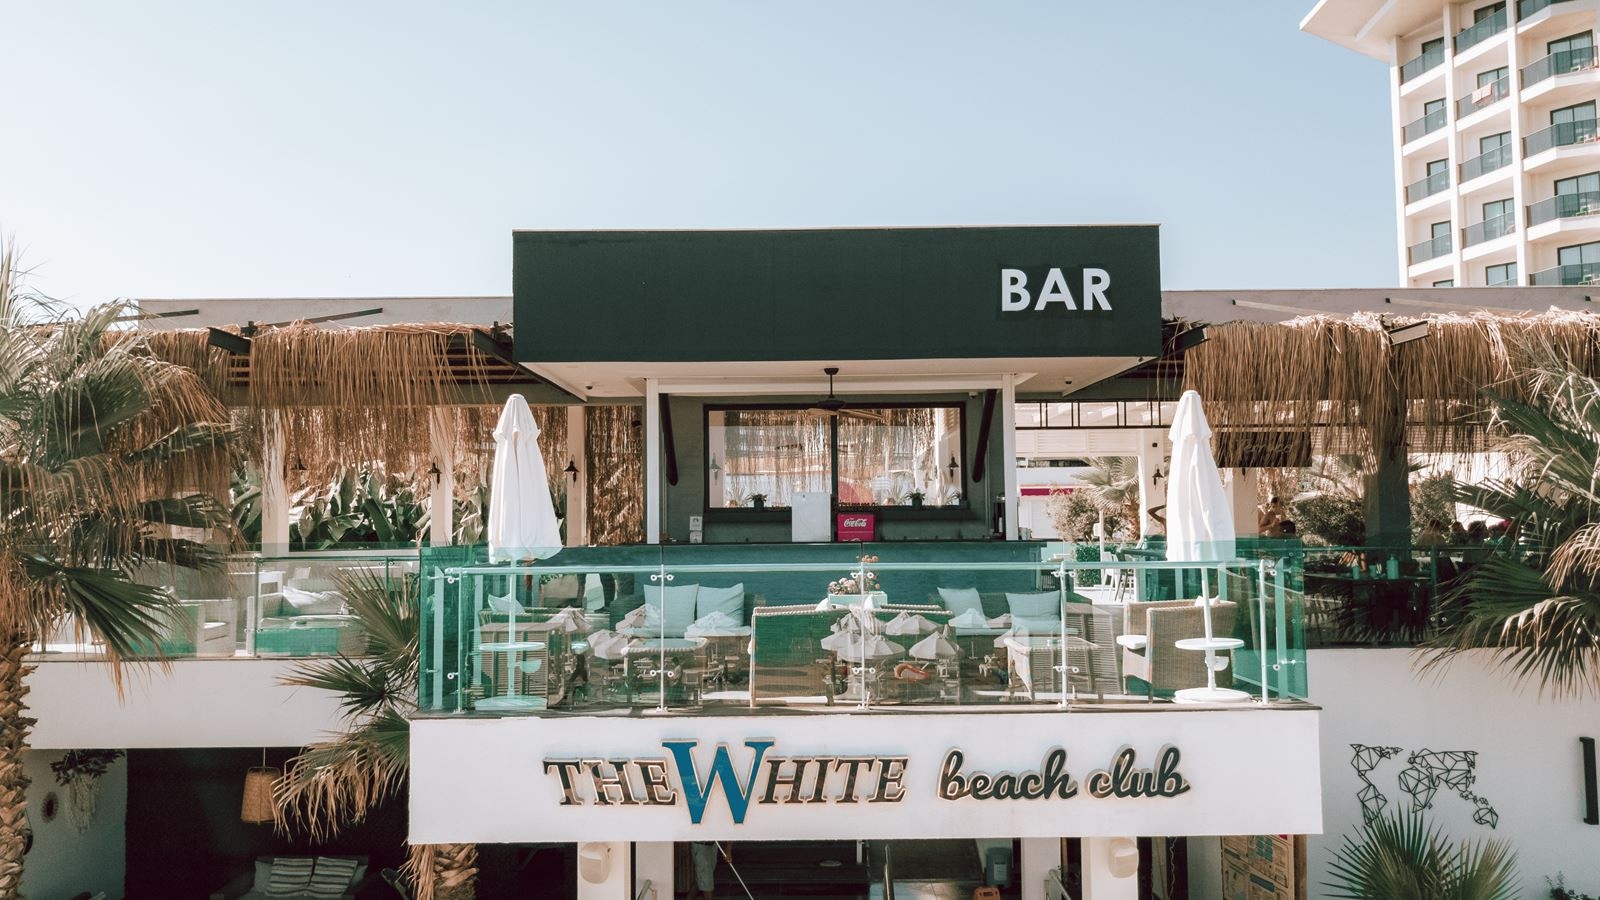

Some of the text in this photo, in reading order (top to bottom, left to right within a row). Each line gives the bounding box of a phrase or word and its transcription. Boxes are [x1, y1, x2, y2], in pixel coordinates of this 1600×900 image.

[1001, 268, 1113, 312] BAR
[542, 738, 1191, 825] THE WHITE beach club
